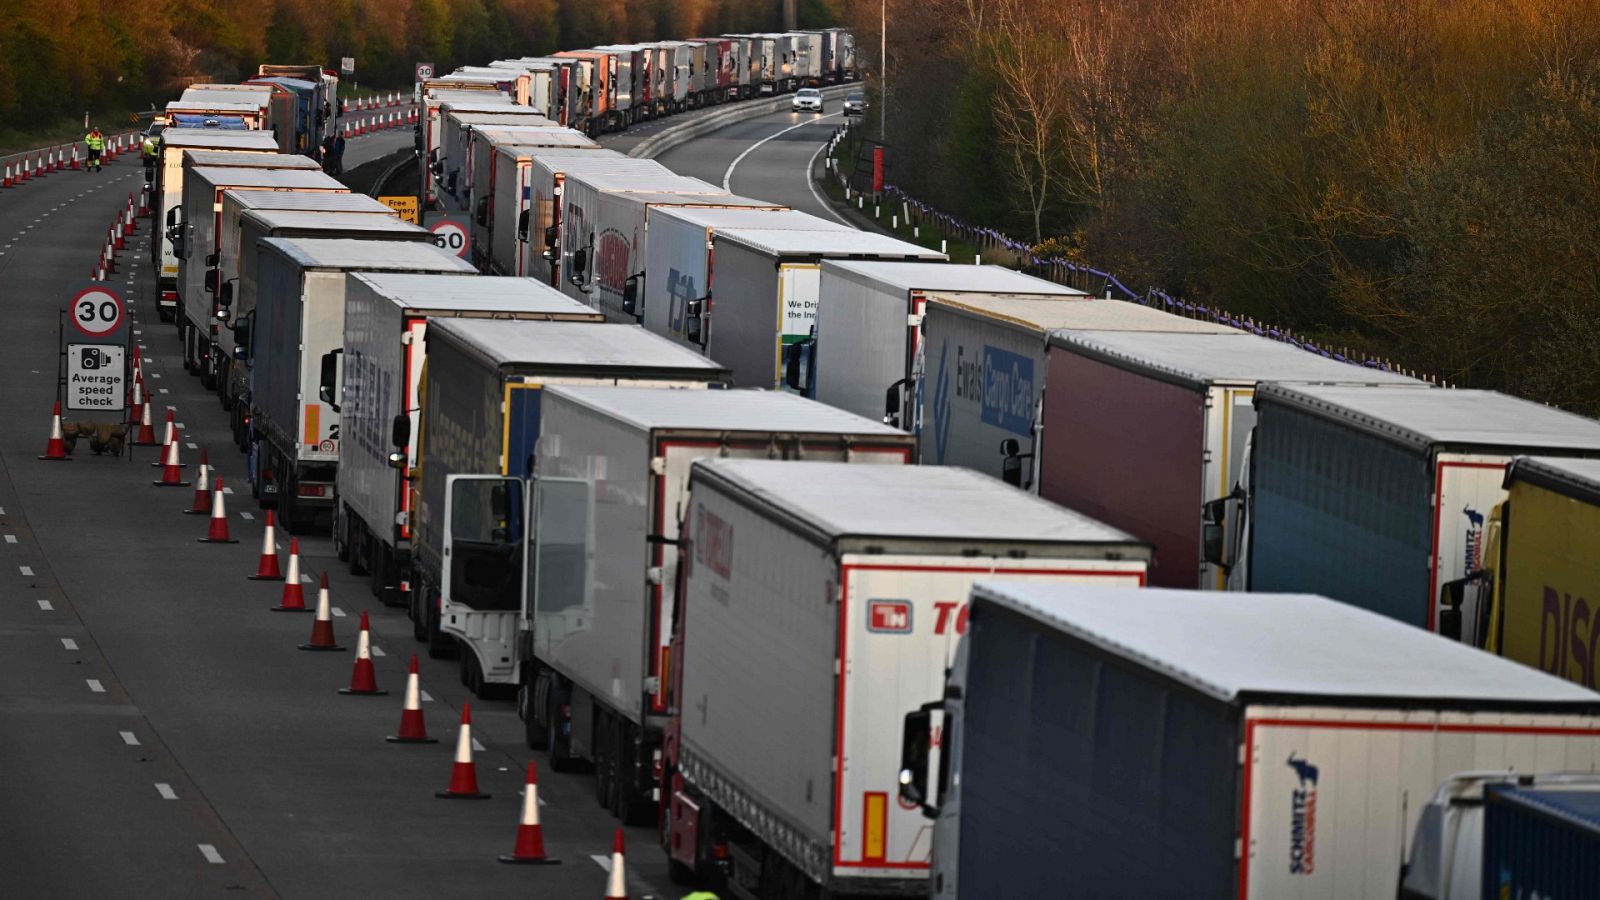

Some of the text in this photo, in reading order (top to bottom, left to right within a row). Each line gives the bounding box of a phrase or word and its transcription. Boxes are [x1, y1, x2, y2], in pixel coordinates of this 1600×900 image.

[388, 199, 407, 207] Free
[434, 233, 463, 249] 50
[788, 300, 802, 308] We
[78, 301, 118, 322] 30
[72, 373, 121, 385] Average
[957, 345, 1031, 424] Ewals Cargo Care
[79, 386, 113, 395] speed
[79, 397, 113, 406] check
[1289, 788, 1306, 874] SCHMITZ
